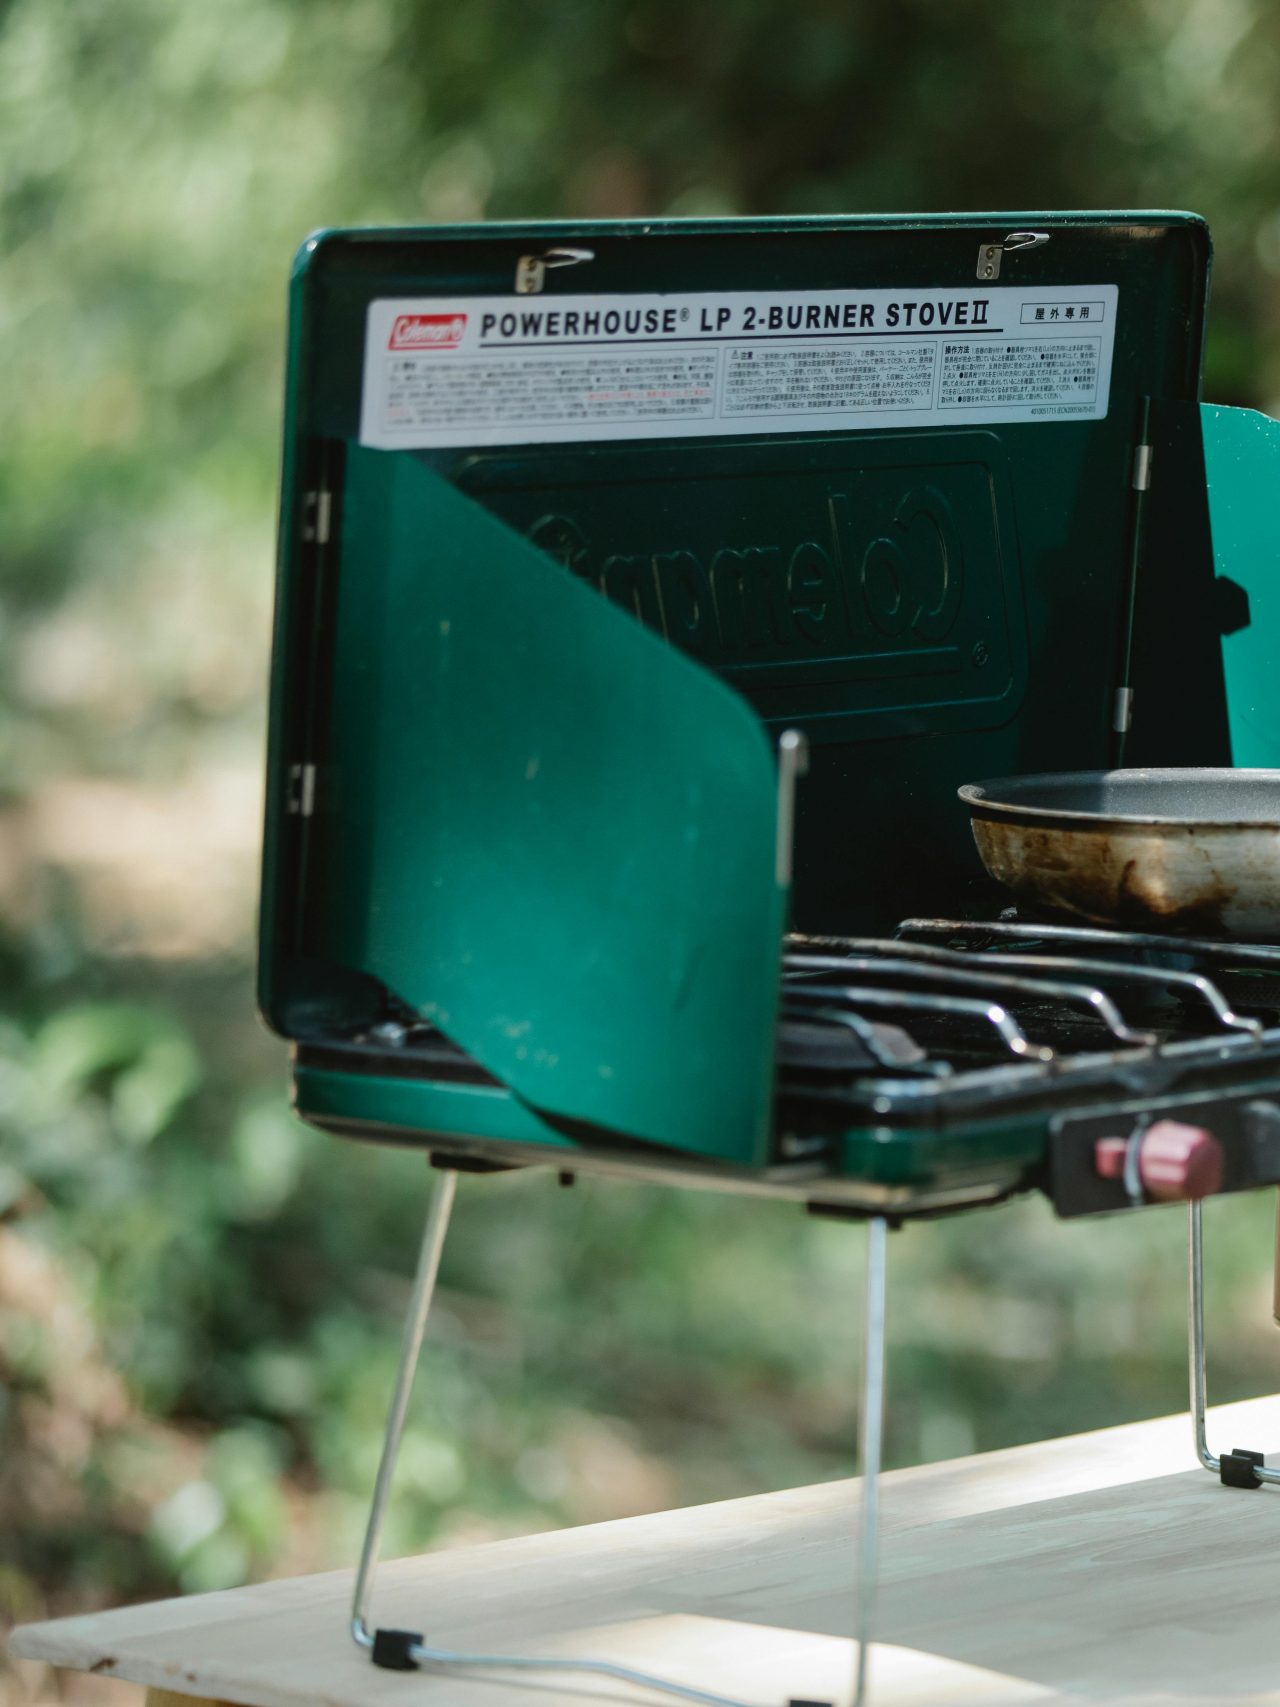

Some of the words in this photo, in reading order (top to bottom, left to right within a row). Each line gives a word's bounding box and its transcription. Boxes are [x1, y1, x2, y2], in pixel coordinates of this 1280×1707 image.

[700, 308, 731, 333] LP
[742, 303, 875, 331] 2-BURNER
[1034, 306, 1090, 320] 屋外専用
